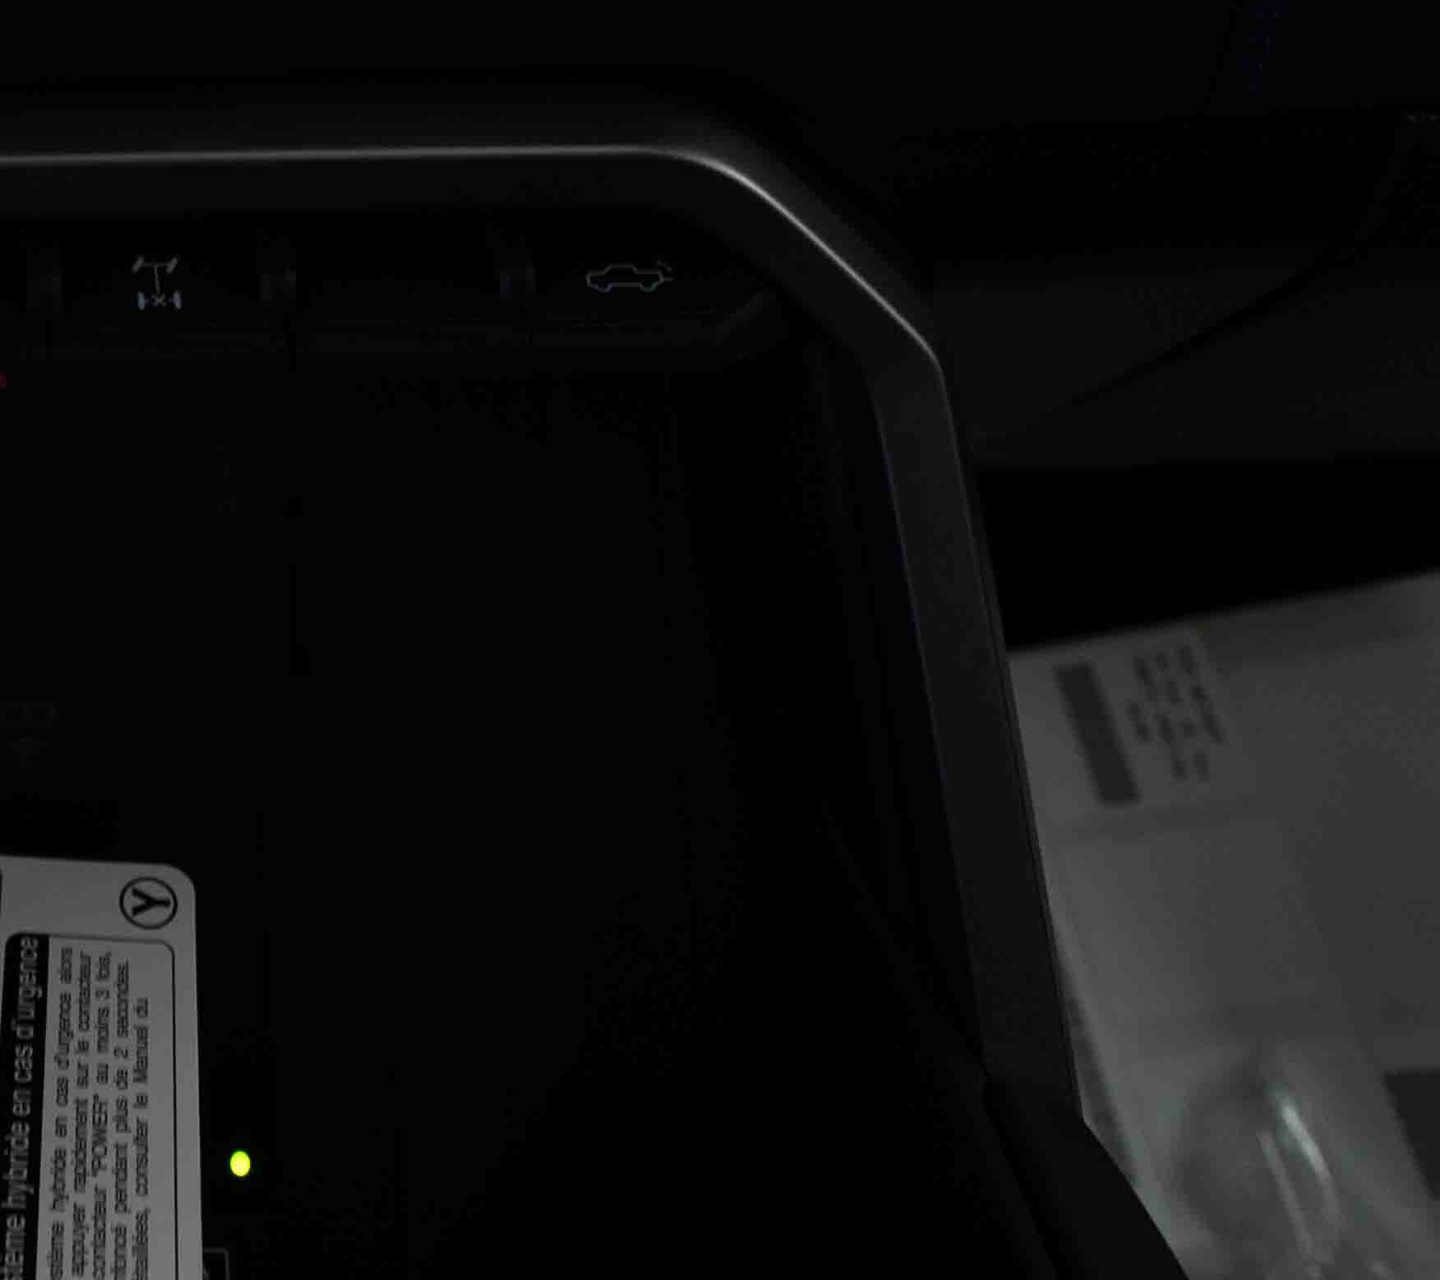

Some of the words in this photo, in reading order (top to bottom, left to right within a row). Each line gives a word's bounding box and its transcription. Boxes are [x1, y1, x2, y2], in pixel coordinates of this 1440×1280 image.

[131, 888, 170, 918] Y
[9, 935, 45, 1041] d'urgence
[12, 1042, 33, 1082] cas
[96, 1063, 108, 1084] au
[55, 1076, 69, 1106] cas
[114, 1068, 128, 1090] de
[11, 1087, 31, 1117] en
[112, 1096, 131, 1133] plus
[54, 1115, 67, 1137] en
[0, 1120, 37, 1210] hybride
[48, 1147, 70, 1211] hybride
[111, 1143, 130, 1212] pendant
